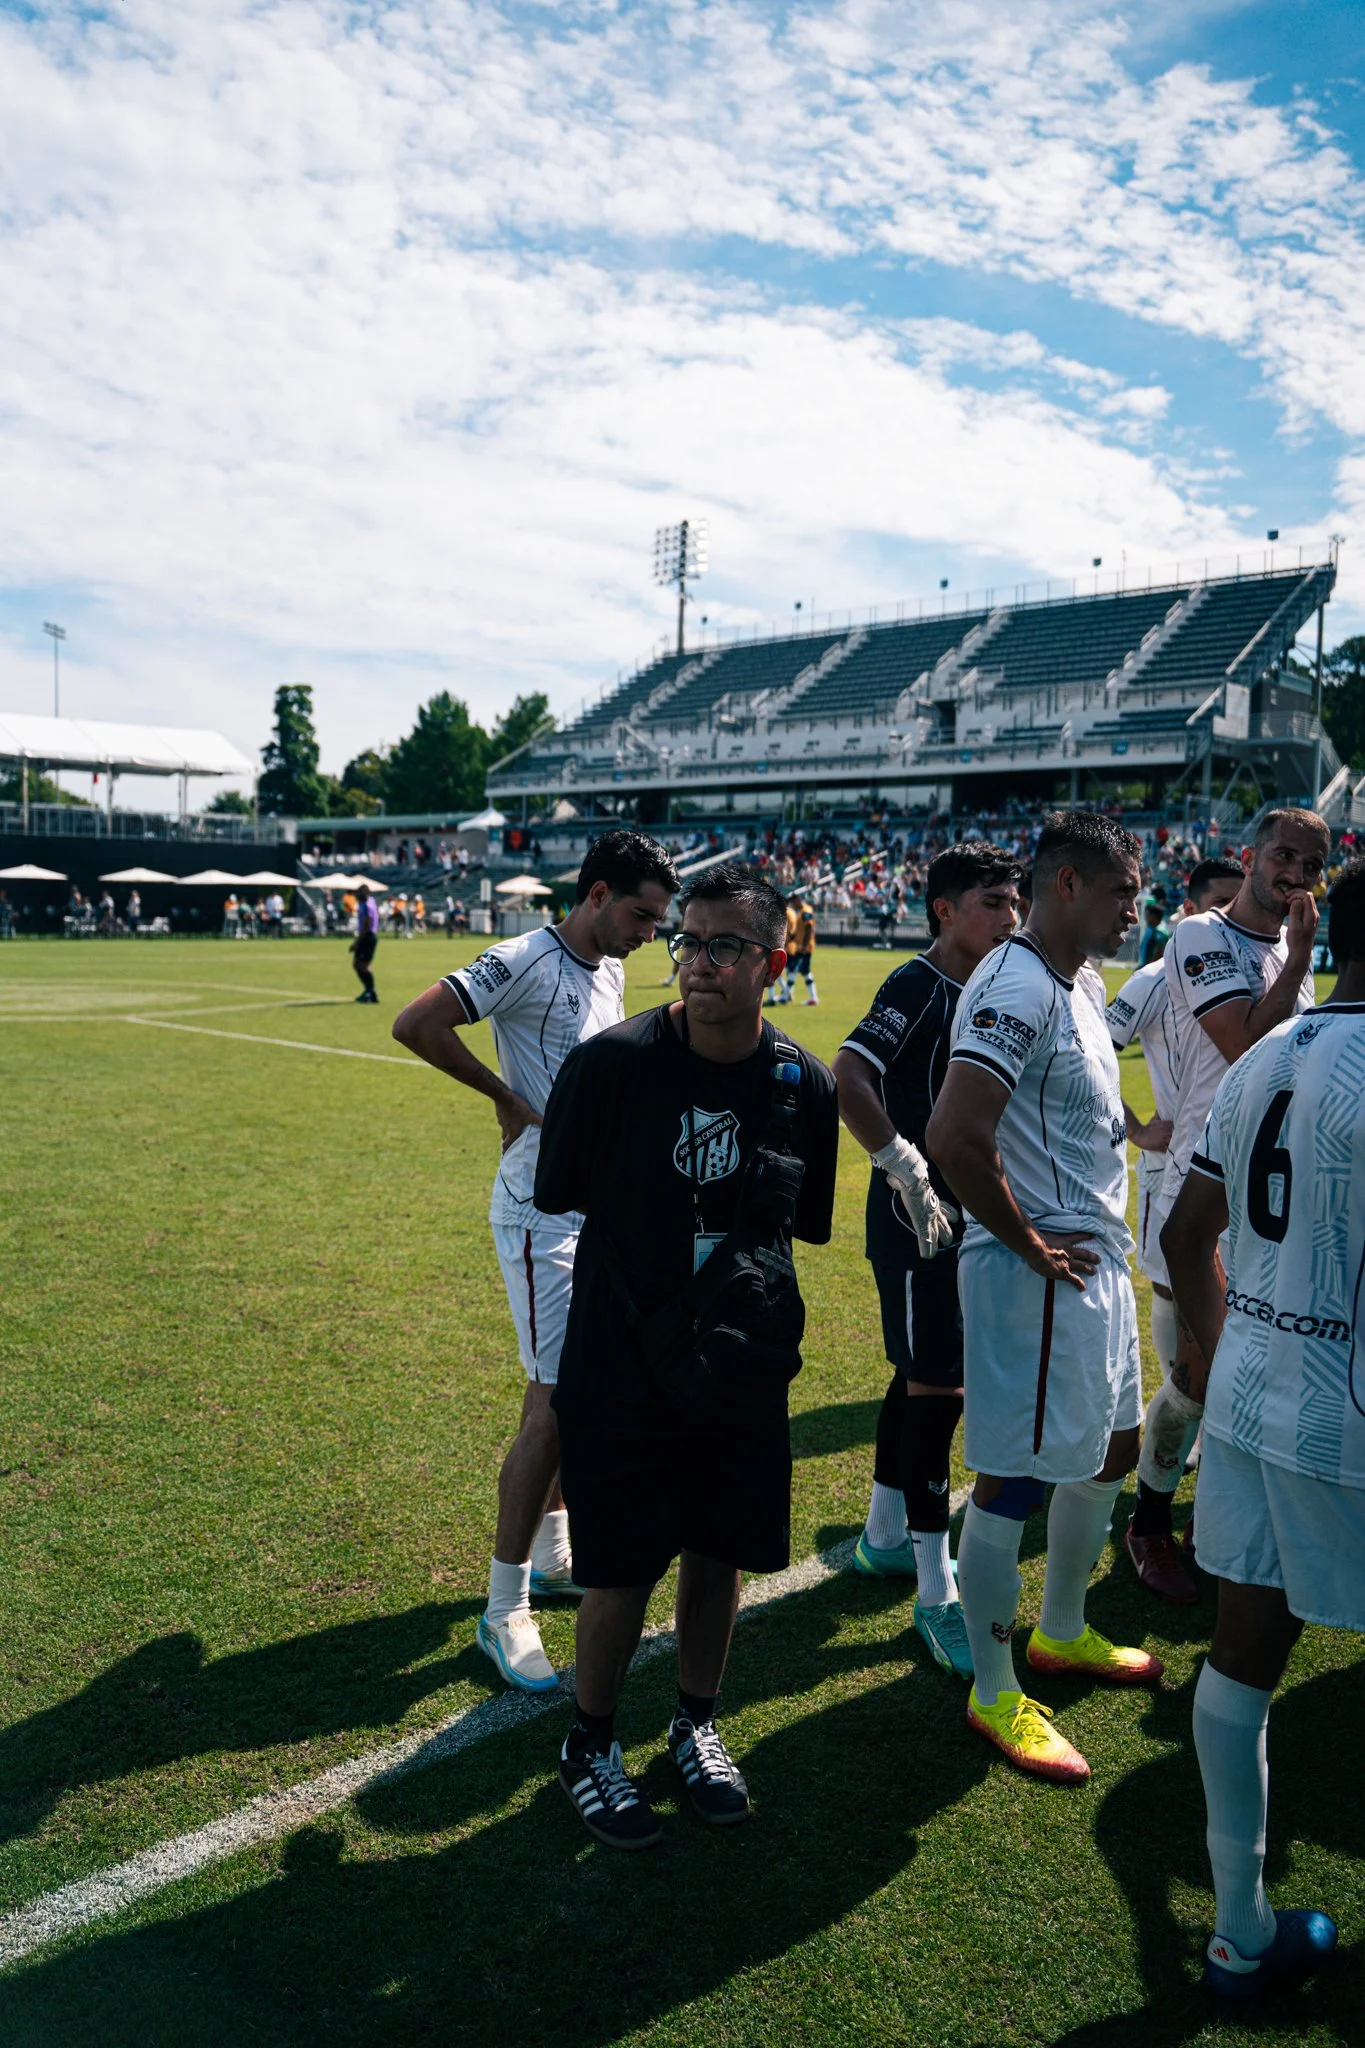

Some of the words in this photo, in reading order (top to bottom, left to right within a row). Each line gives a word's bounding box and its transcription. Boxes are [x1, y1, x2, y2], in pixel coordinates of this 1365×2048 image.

[996, 1024, 1031, 1048] LATINO
[679, 1136, 703, 1157] SOCER
[702, 1117, 733, 1140] CENTRAL
[1248, 1090, 1293, 1244] 6
